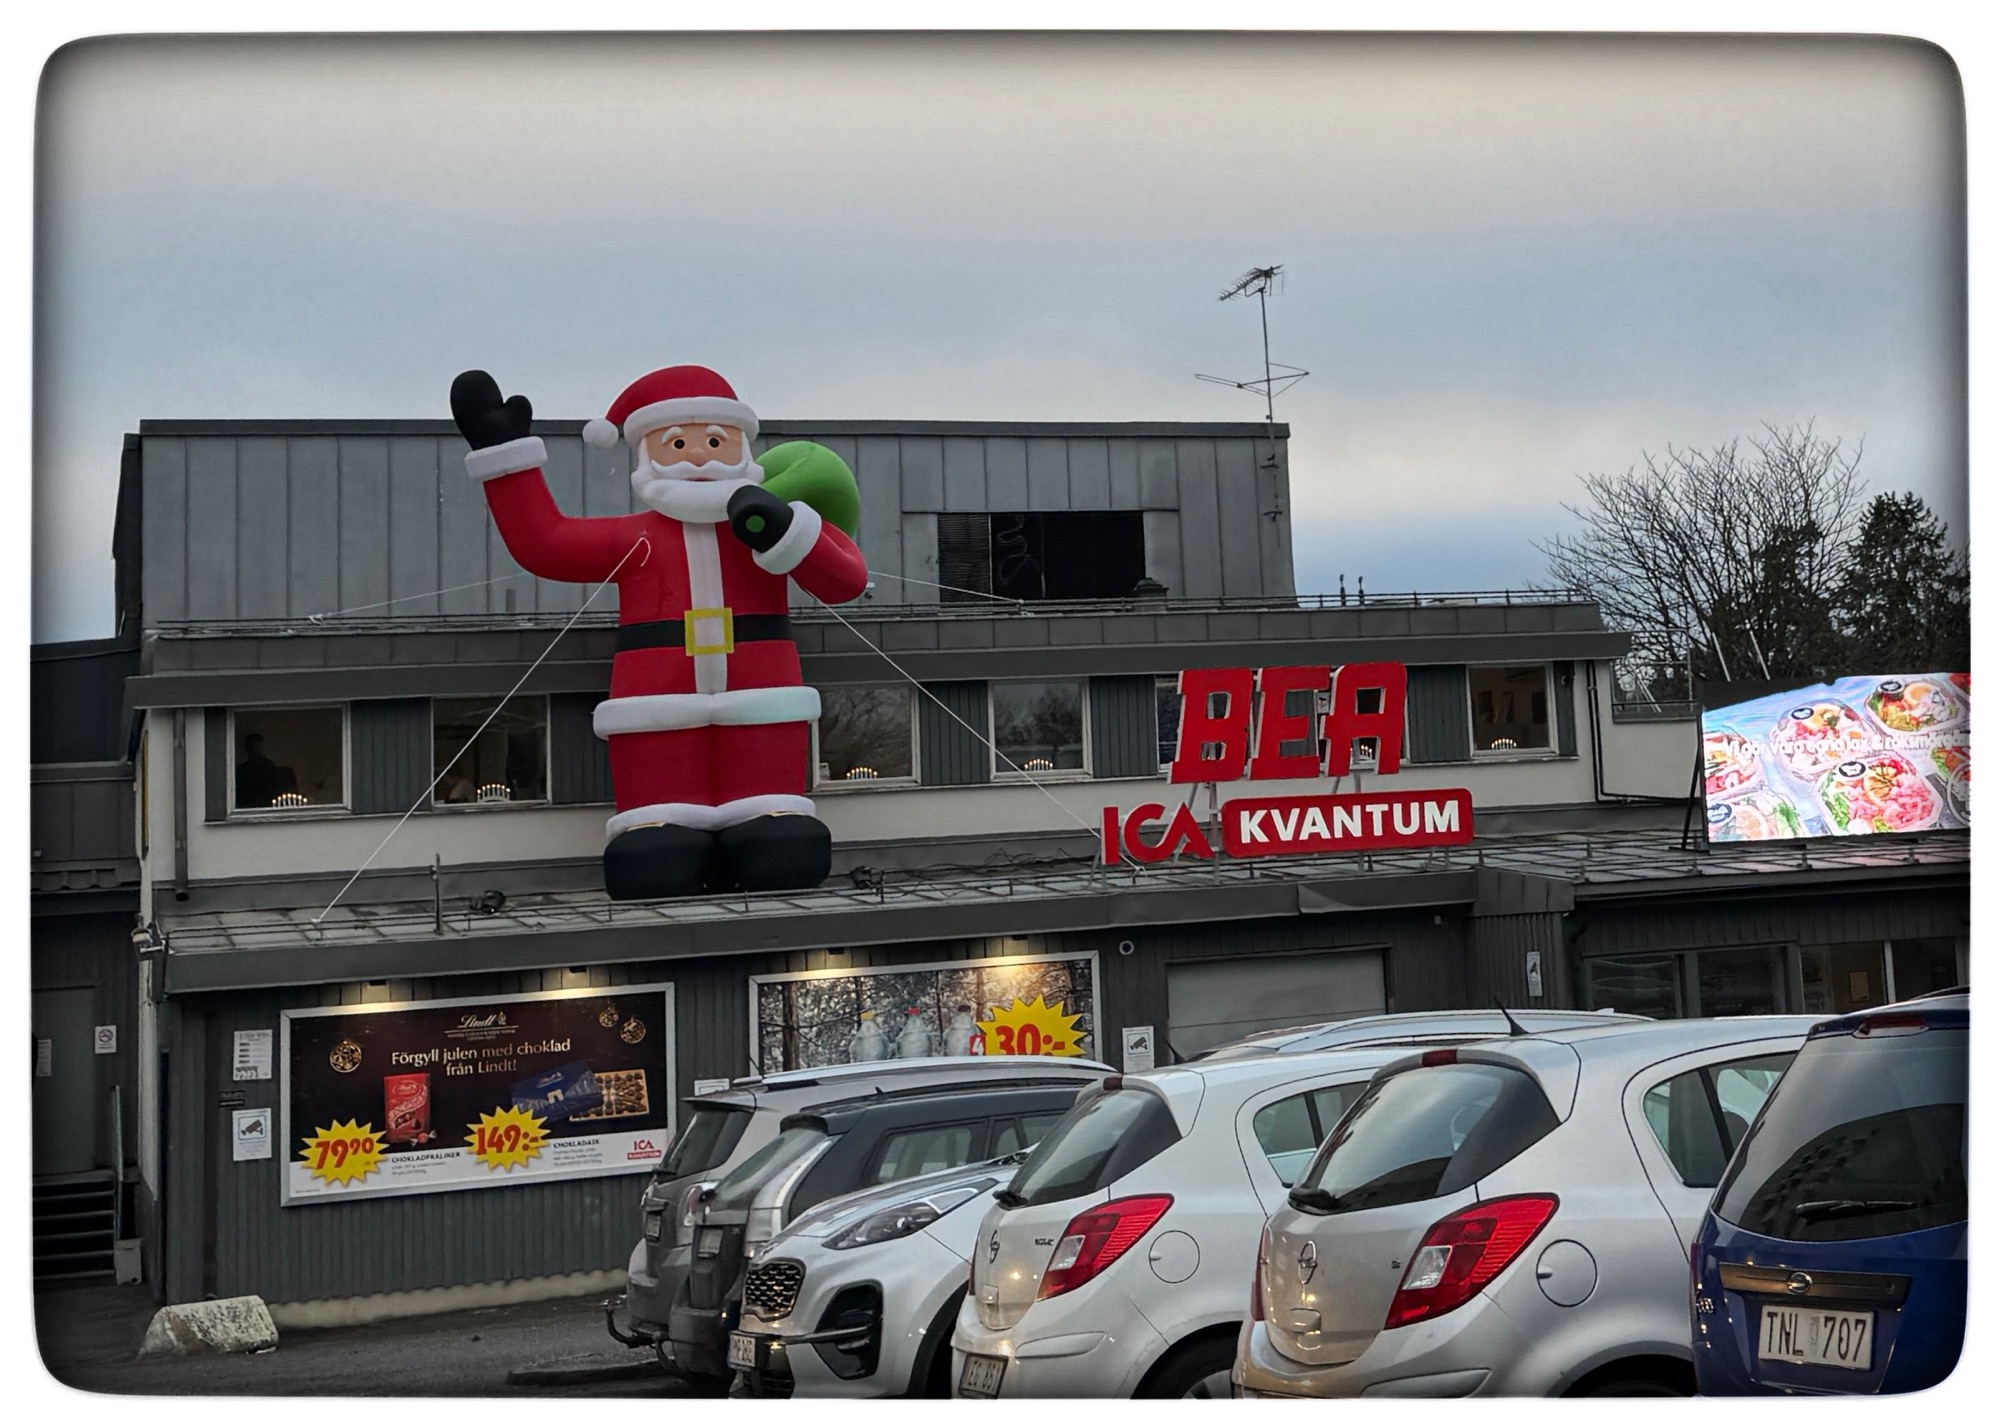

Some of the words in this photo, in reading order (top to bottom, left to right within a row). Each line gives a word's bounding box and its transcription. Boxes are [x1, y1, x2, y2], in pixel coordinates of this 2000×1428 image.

[1167, 661, 1407, 784] BEA
[1101, 801, 1215, 866] ICA
[1240, 800, 1460, 844] KVANTUM
[457, 1014, 497, 1028] Lindt
[391, 1049, 439, 1068] Förgyll
[443, 1047, 478, 1064] julen
[482, 1043, 513, 1058] med
[517, 1038, 571, 1055] choklad
[446, 1062, 474, 1076] från
[478, 1059, 517, 1073] Lindt!
[476, 1124, 539, 1156] 149:-
[633, 1139, 655, 1151] ICA
[1767, 1312, 1804, 1357] TNL
[1823, 1316, 1867, 1361] 707
